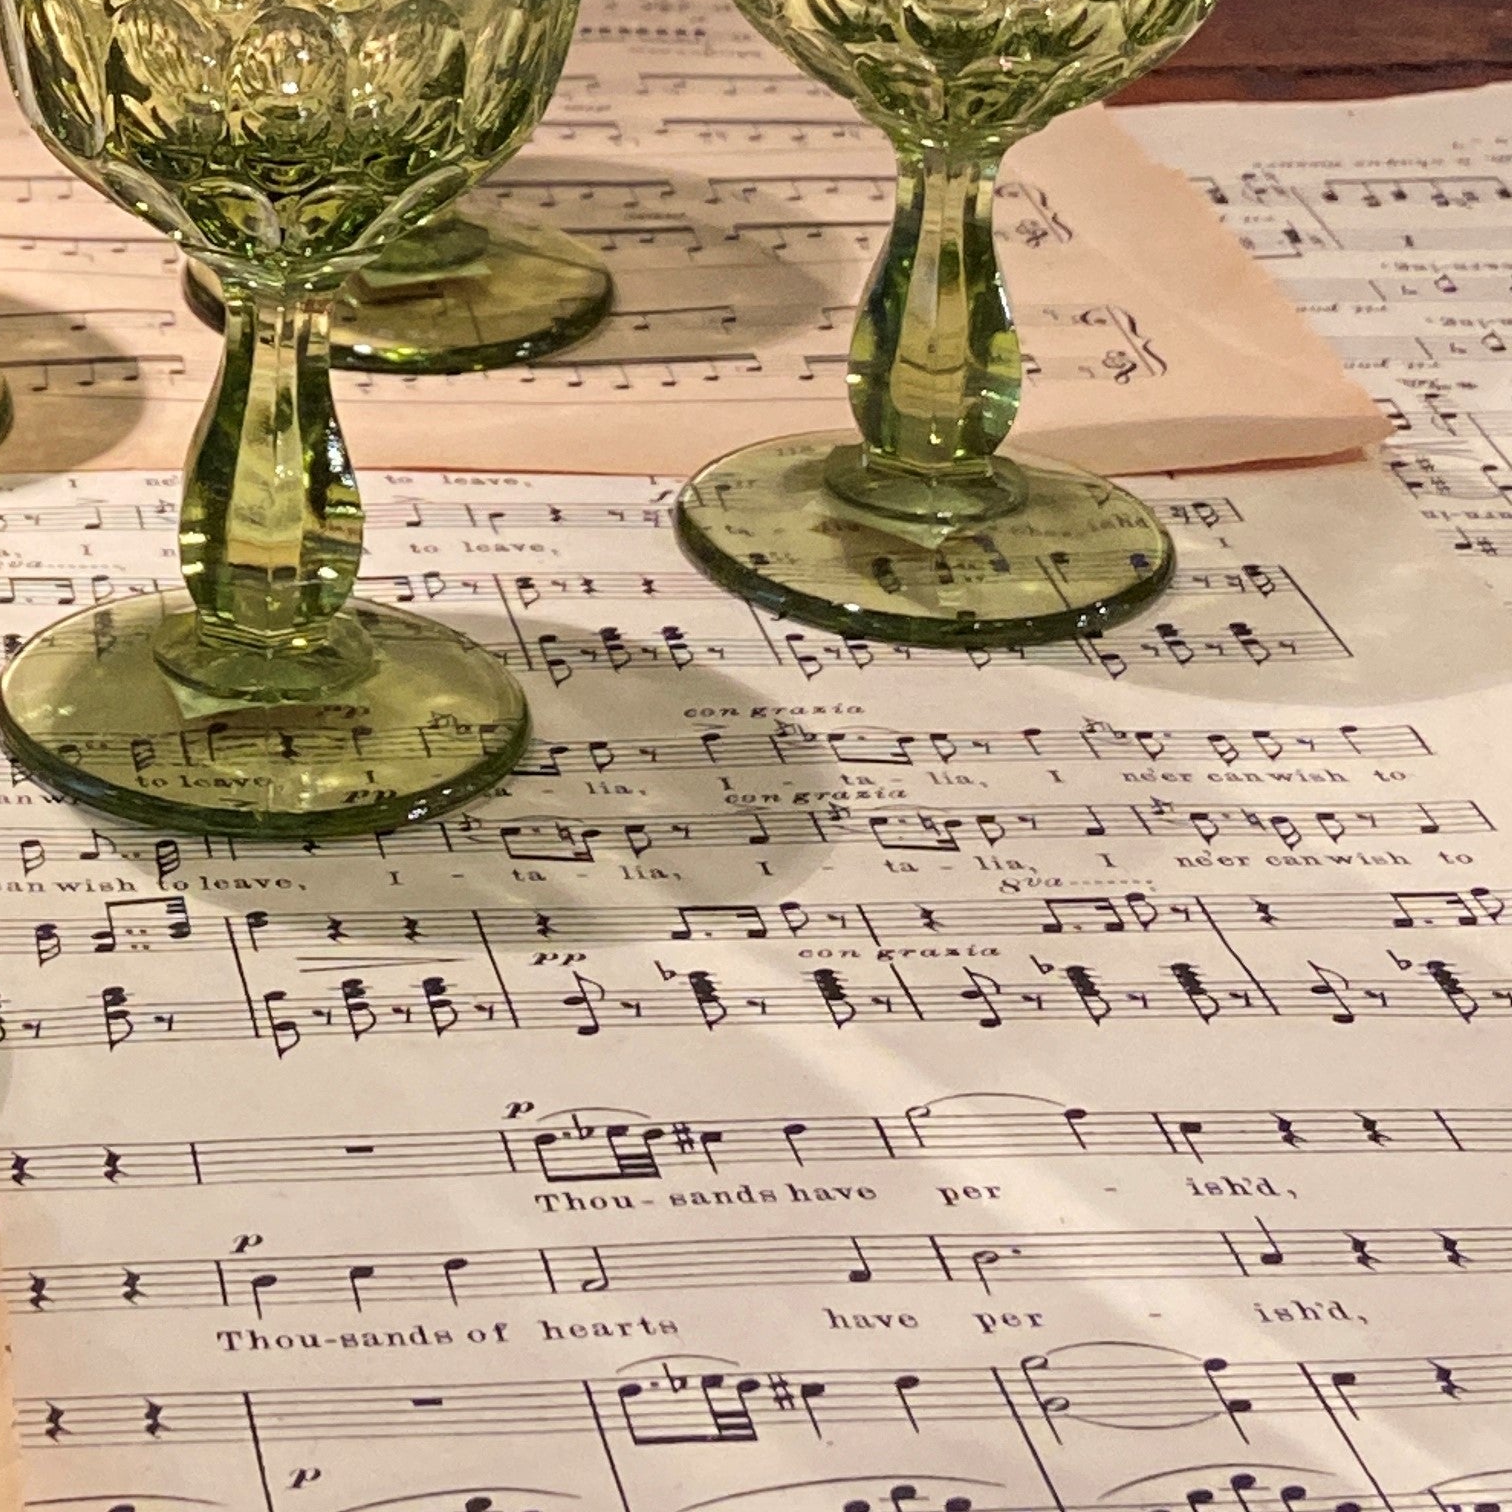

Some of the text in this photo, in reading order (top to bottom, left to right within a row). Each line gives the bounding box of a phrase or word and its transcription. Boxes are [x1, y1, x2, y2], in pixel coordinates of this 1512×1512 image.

[408, 542, 440, 554] to
[683, 701, 866, 720] con grazia
[1207, 769, 1264, 784] can
[1271, 768, 1349, 784] wish
[1373, 767, 1407, 783] to
[724, 786, 909, 806] con grazia
[55, 876, 138, 893] wish
[201, 874, 309, 892] leave,
[618, 863, 683, 882] lia,
[972, 854, 1039, 875] lia,
[1174, 849, 1252, 869] ne'er
[1265, 853, 1323, 868] can
[1327, 851, 1412, 868] wish
[1437, 850, 1475, 867] to
[797, 944, 1002, 962] con grazia
[669, 1184, 779, 1208] sands
[784, 1182, 879, 1202] have
[936, 1185, 1002, 1208] per
[466, 1321, 510, 1344] of
[537, 1315, 680, 1342] hearts
[823, 1306, 921, 1332] have
[974, 1308, 1045, 1335] per
